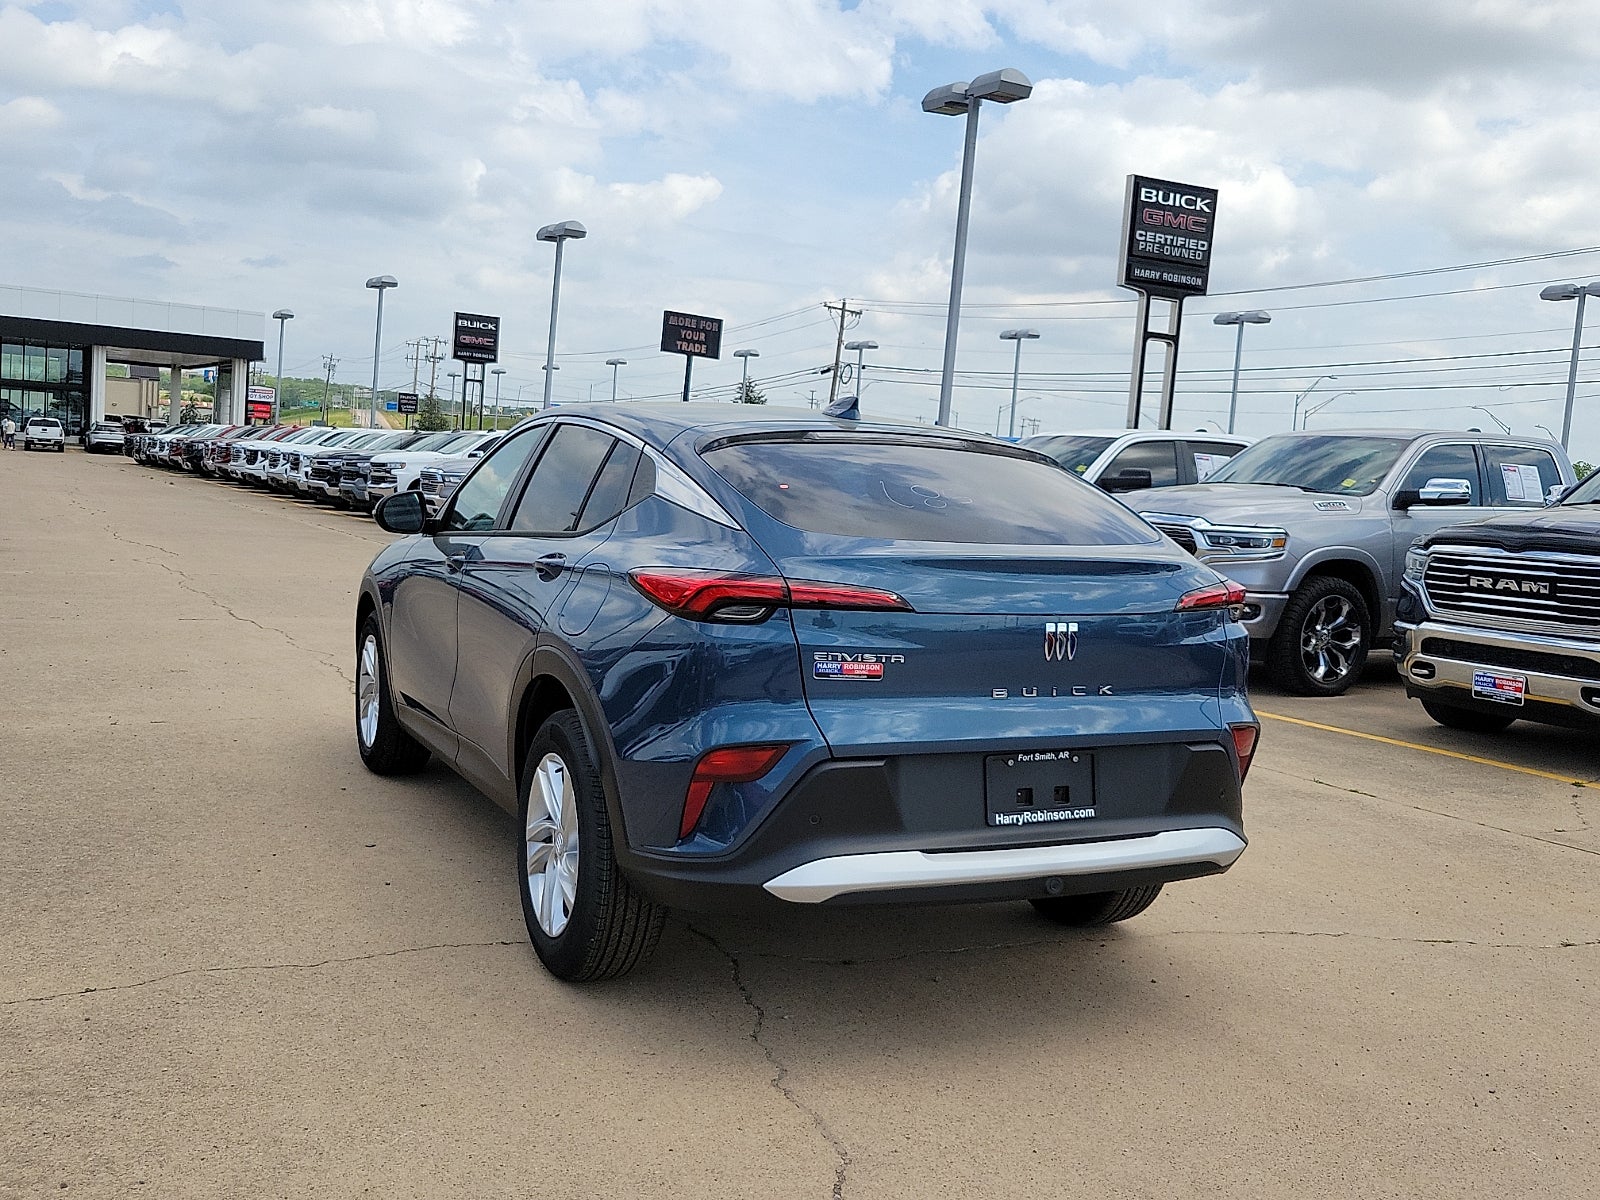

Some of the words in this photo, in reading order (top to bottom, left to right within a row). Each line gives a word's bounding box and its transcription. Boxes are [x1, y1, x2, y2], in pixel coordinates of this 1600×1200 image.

[1140, 187, 1212, 213] BUICK
[1142, 208, 1207, 233] GMC
[1135, 230, 1208, 251] CERTIFIED
[1138, 241, 1203, 260] PRE-OWNED
[1134, 267, 1161, 280] HARRY
[1162, 272, 1202, 286] ROBINSON
[458, 319, 496, 330] BUICK
[669, 315, 697, 328] MORE
[700, 320, 719, 332] FOR
[460, 335, 494, 345] GMC
[680, 329, 706, 341] YOUR
[676, 340, 707, 354] TRADE
[1469, 576, 1549, 594] RAM
[813, 652, 905, 663] ENVISTA
[992, 685, 1113, 699] BUICK
[1018, 754, 1034, 762] Fort
[1034, 752, 1057, 762] Smith,
[1058, 751, 1070, 760] AR
[995, 808, 1096, 826] HarryRobinson.com
